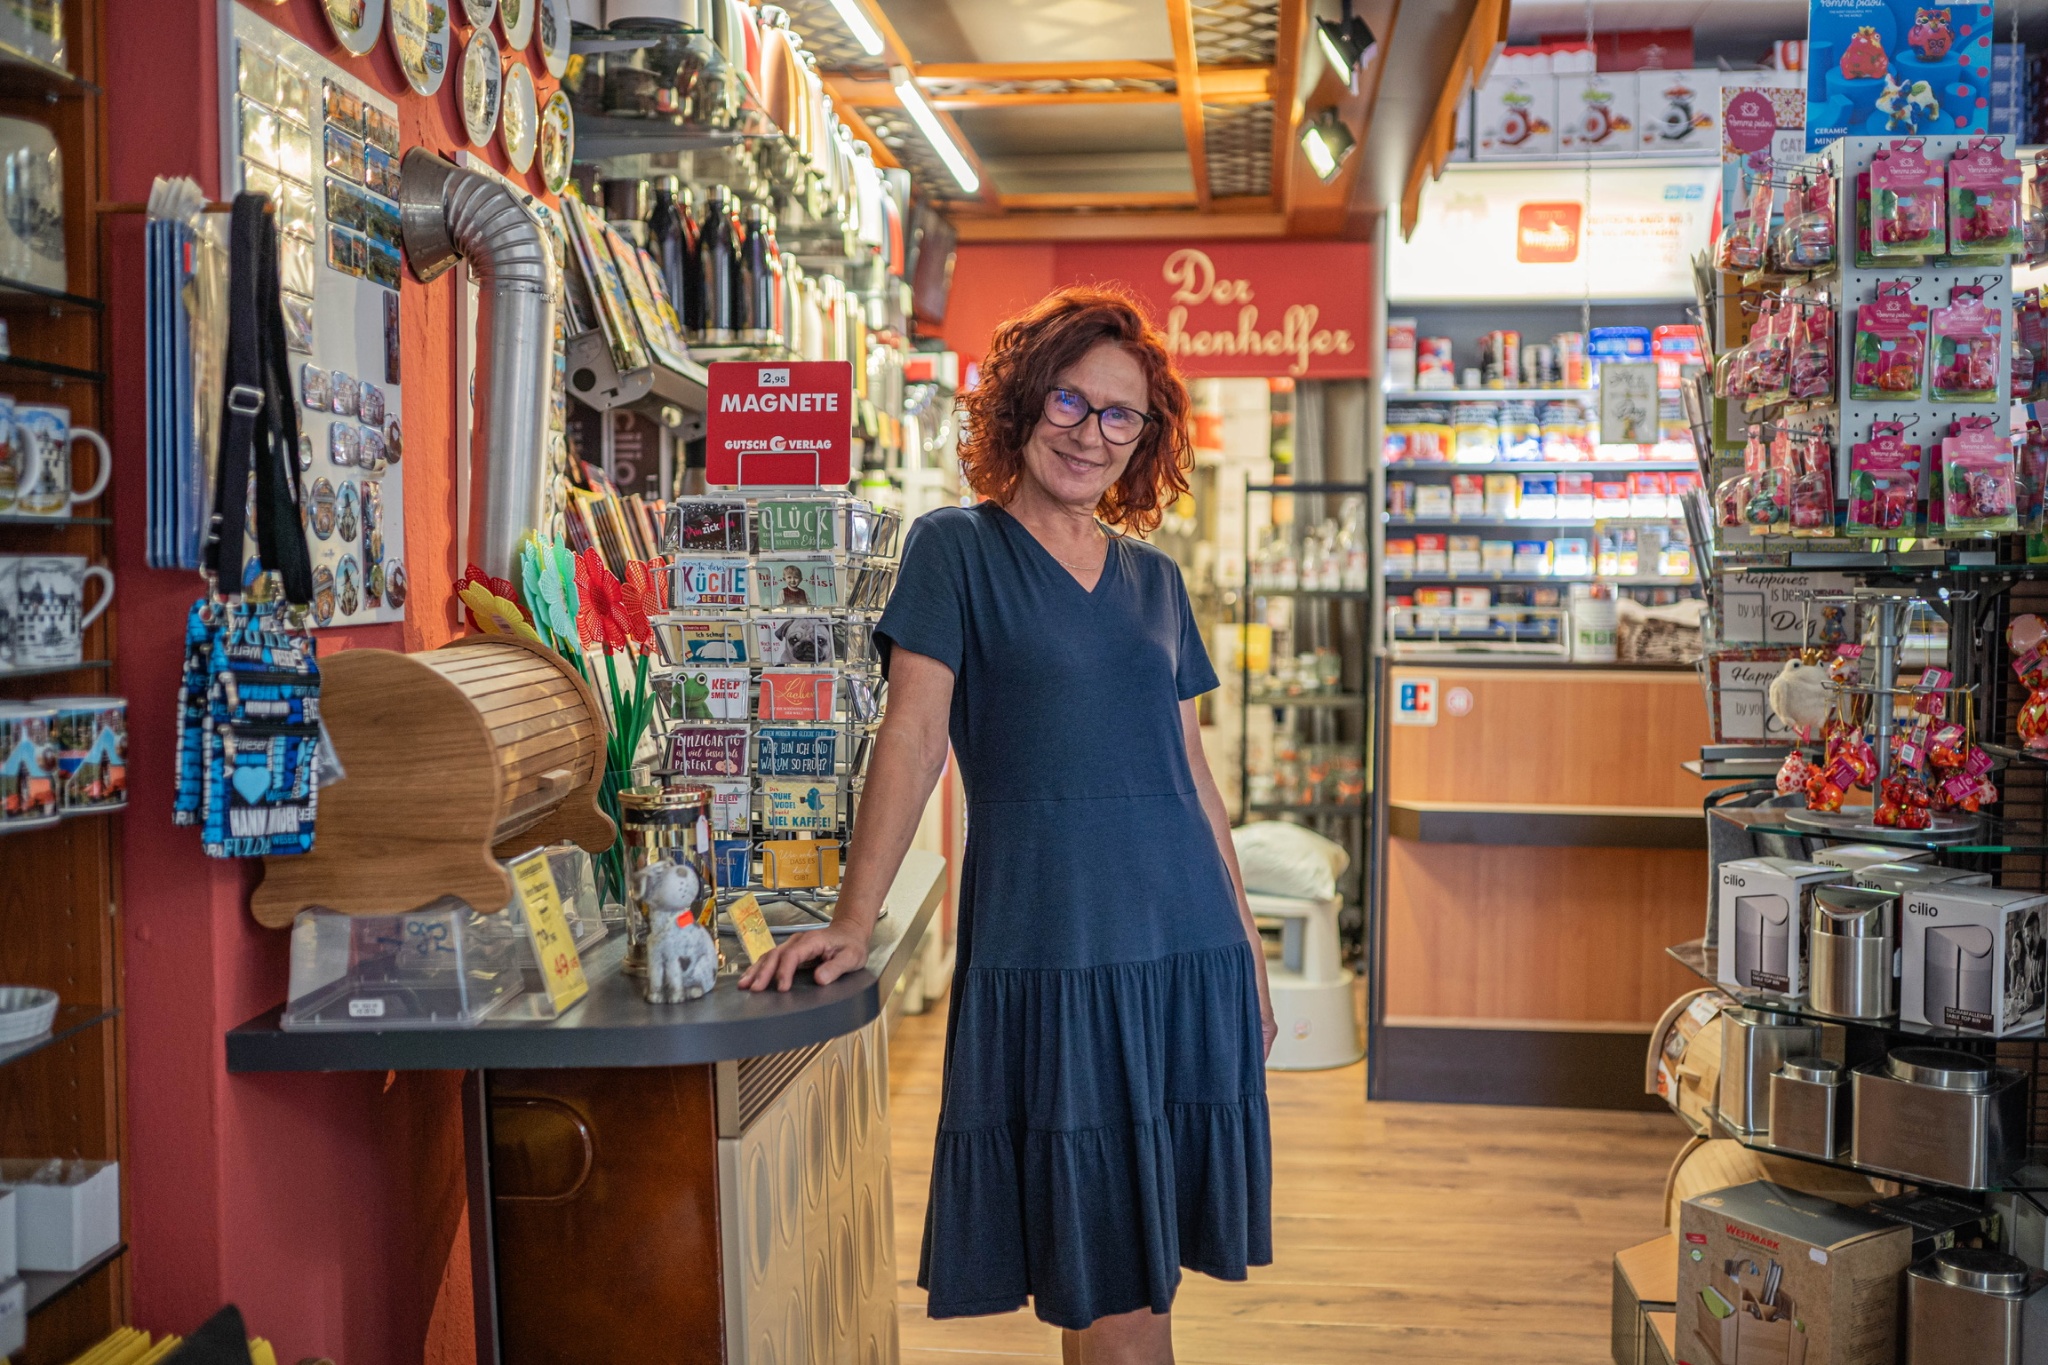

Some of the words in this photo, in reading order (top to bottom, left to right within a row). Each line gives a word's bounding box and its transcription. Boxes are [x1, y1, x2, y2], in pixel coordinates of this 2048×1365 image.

[1814, 127, 1848, 135] CERAMIC
[1162, 248, 1255, 305] Der
[763, 372, 786, 385] 2,95
[720, 393, 838, 413] MAGNETE
[725, 440, 767, 451] GUTSCH
[789, 440, 832, 451] VERLAG
[761, 505, 828, 535] GLÜCK
[682, 566, 746, 592] KÜCHE
[1735, 572, 1810, 589] Happiness
[1738, 603, 1749, 618] by
[1771, 610, 1818, 640] Dog
[1731, 666, 1780, 685] Happi
[711, 678, 741, 690] KEEP
[688, 748, 702, 758] viel
[781, 741, 794, 754] BIN
[796, 743, 809, 755] ICH
[791, 758, 801, 770] SO
[768, 816, 788, 826] VIEL
[1723, 874, 1746, 887] cilio
[1908, 901, 1938, 918] cilio
[1726, 1223, 1780, 1250] WESTMARK
